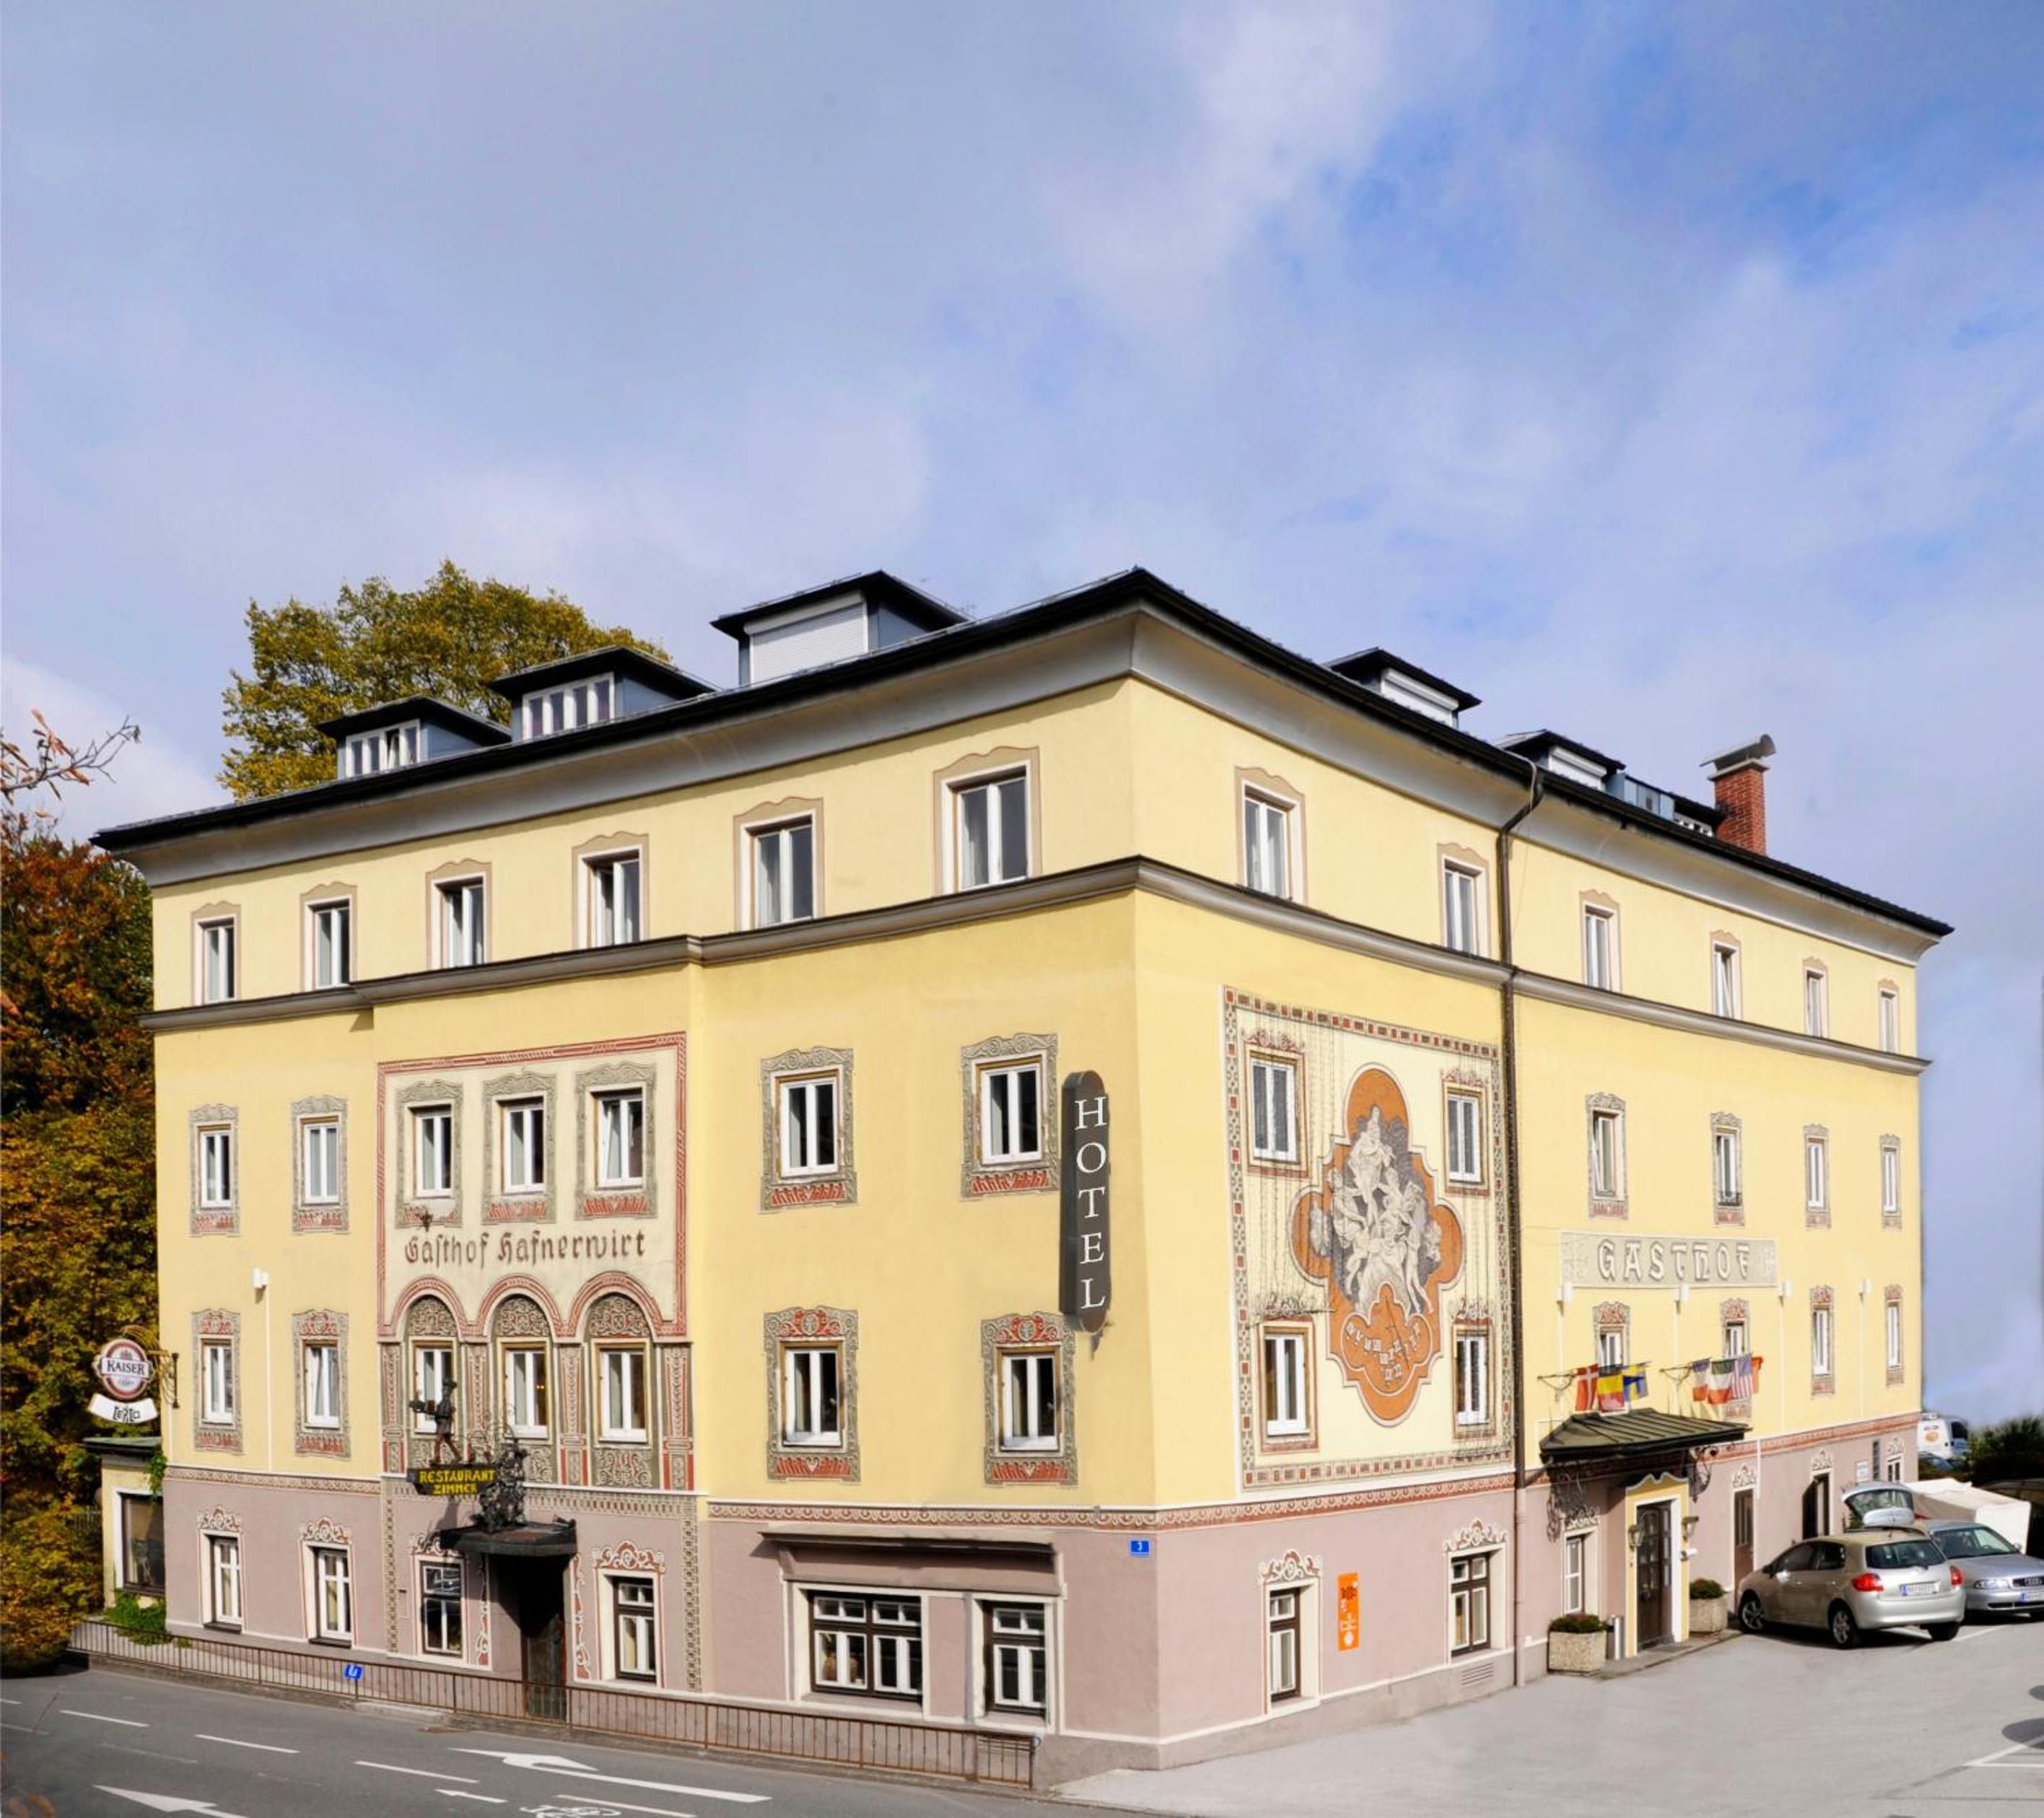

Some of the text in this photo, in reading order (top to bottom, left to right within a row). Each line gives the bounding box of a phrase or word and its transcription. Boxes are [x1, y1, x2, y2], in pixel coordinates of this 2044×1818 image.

[1074, 1096, 1108, 1310] HOTEL
[1598, 1238, 1750, 1282] GASTHOF
[107, 1359, 145, 1376] KAISER
[419, 1469, 496, 1483] RESTAURANT
[433, 1482, 478, 1495] ZIMMER
